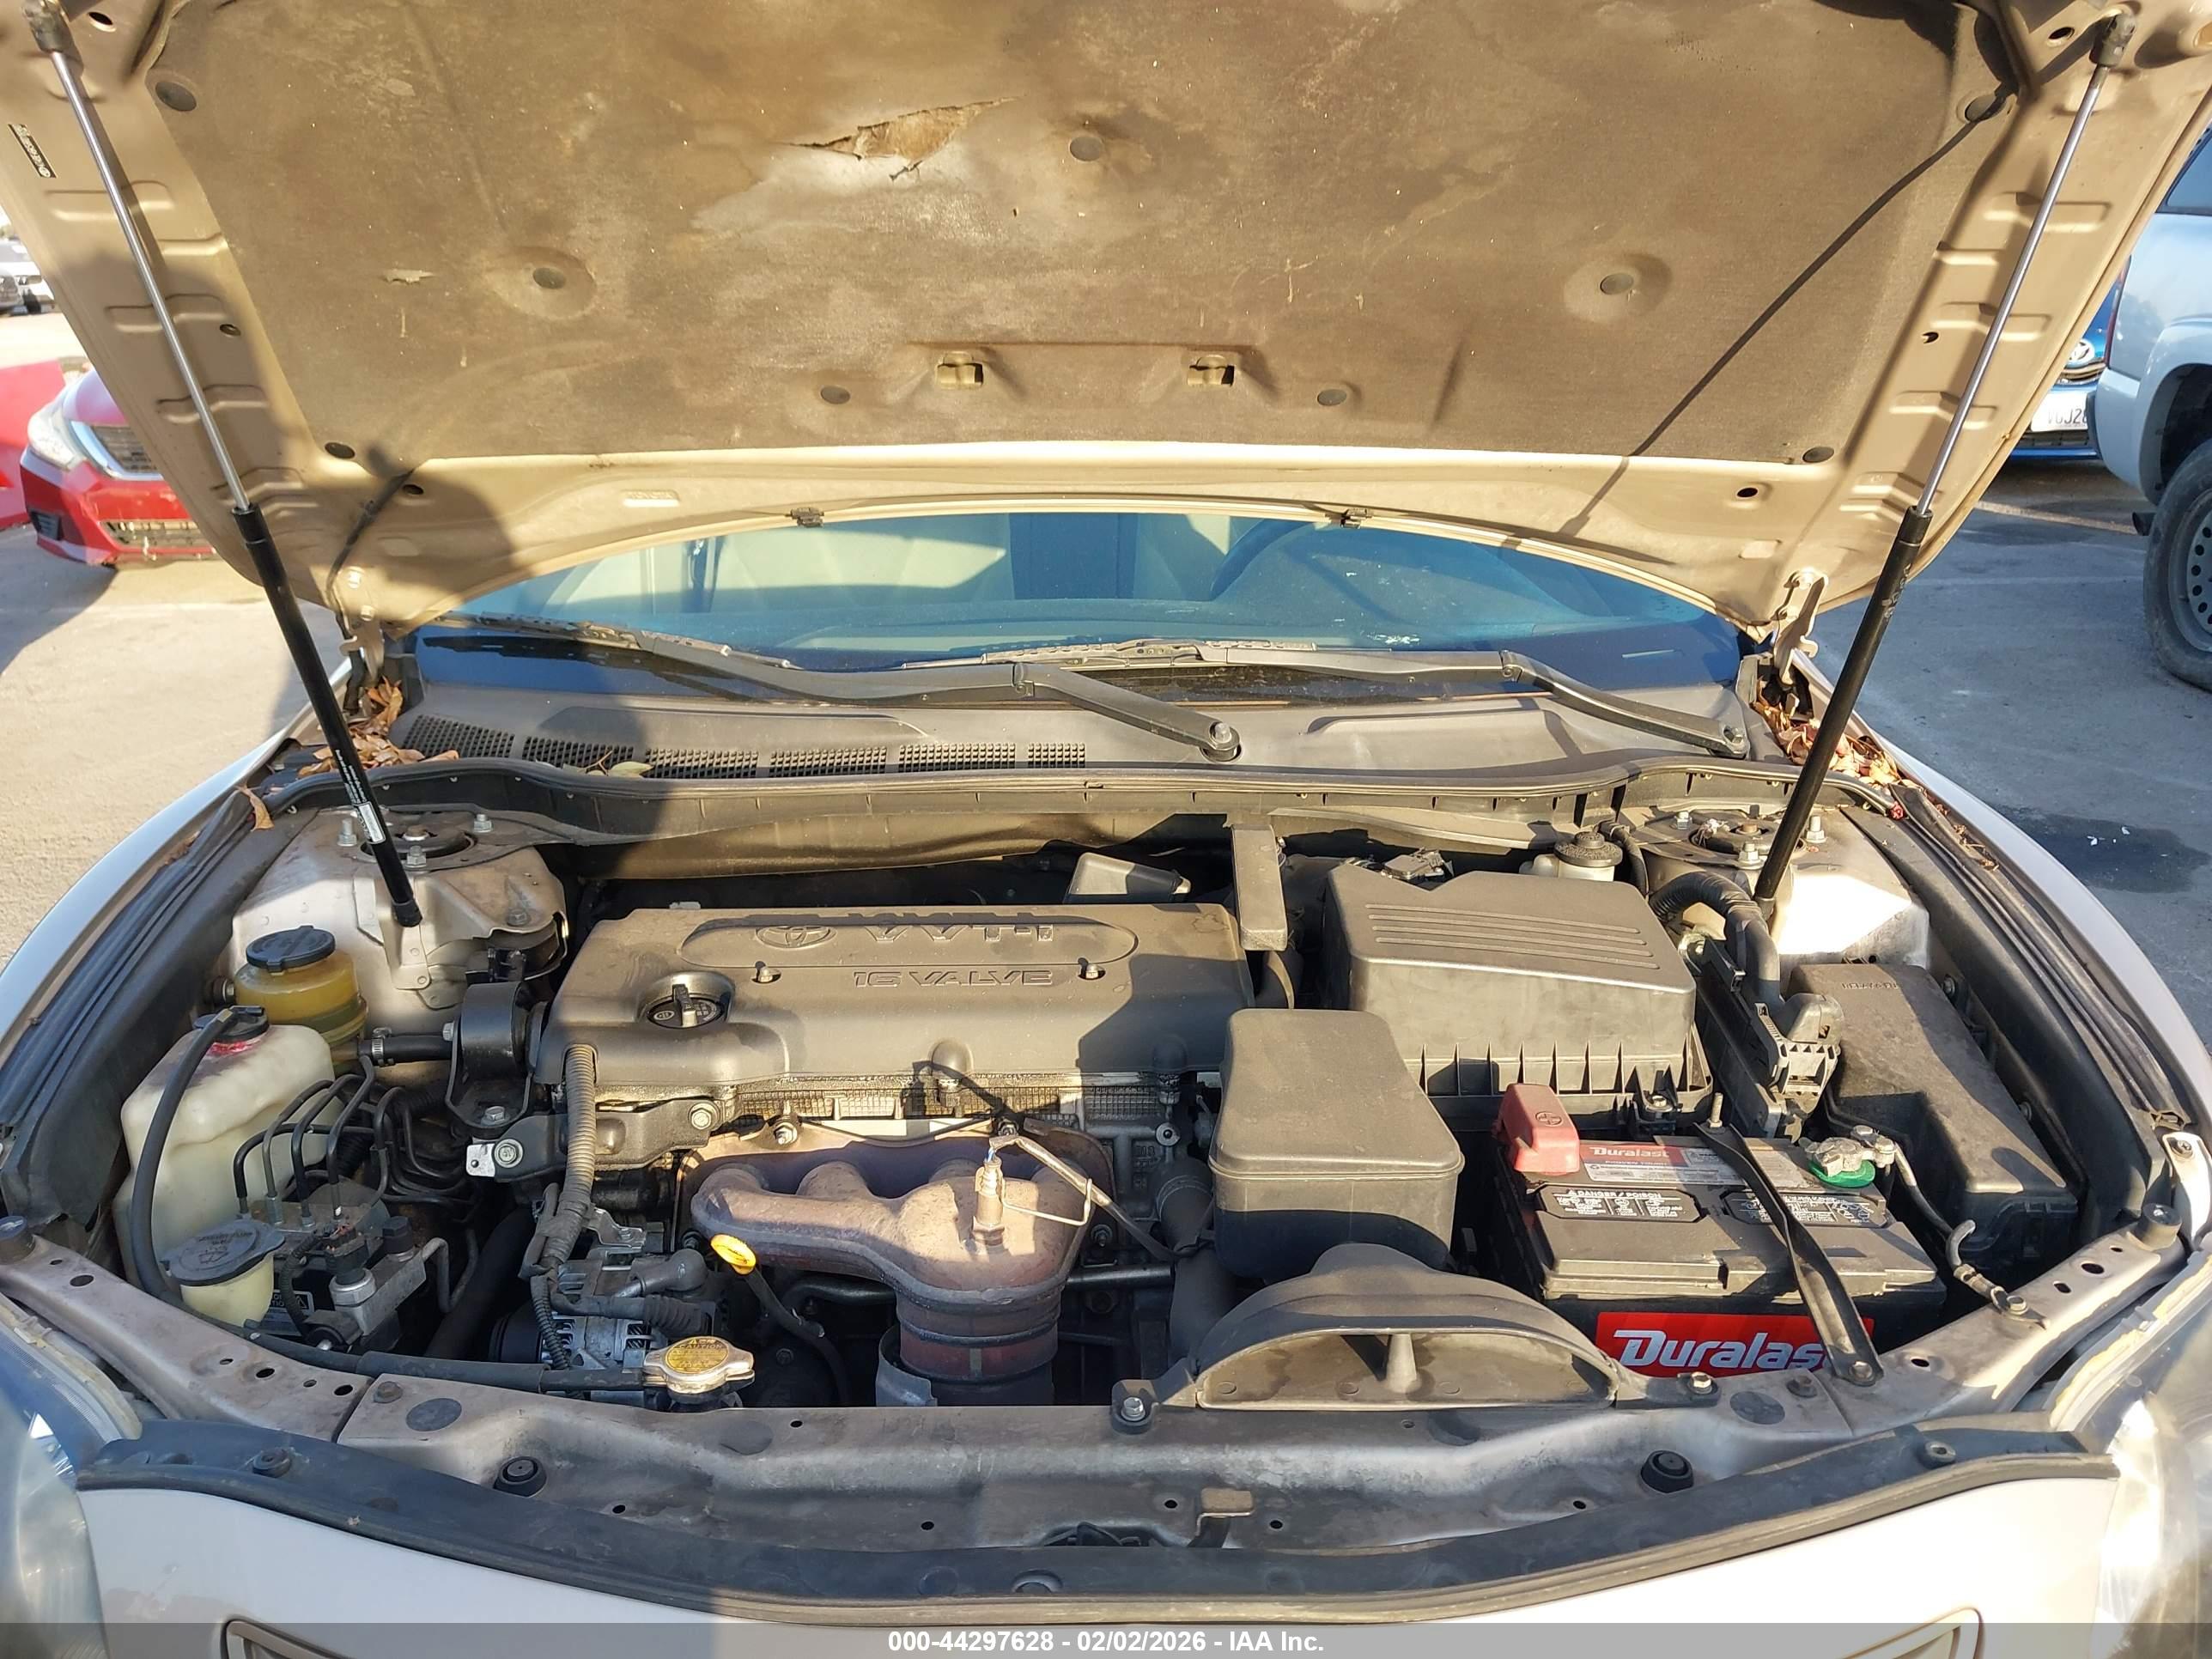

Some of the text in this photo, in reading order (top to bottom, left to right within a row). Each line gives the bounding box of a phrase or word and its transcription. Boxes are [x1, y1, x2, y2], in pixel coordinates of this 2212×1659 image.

[854, 969, 1053, 988] 16 VALVE
[1589, 1146, 1670, 1158] Duralast
[1613, 1329, 1829, 1370] Duralas
